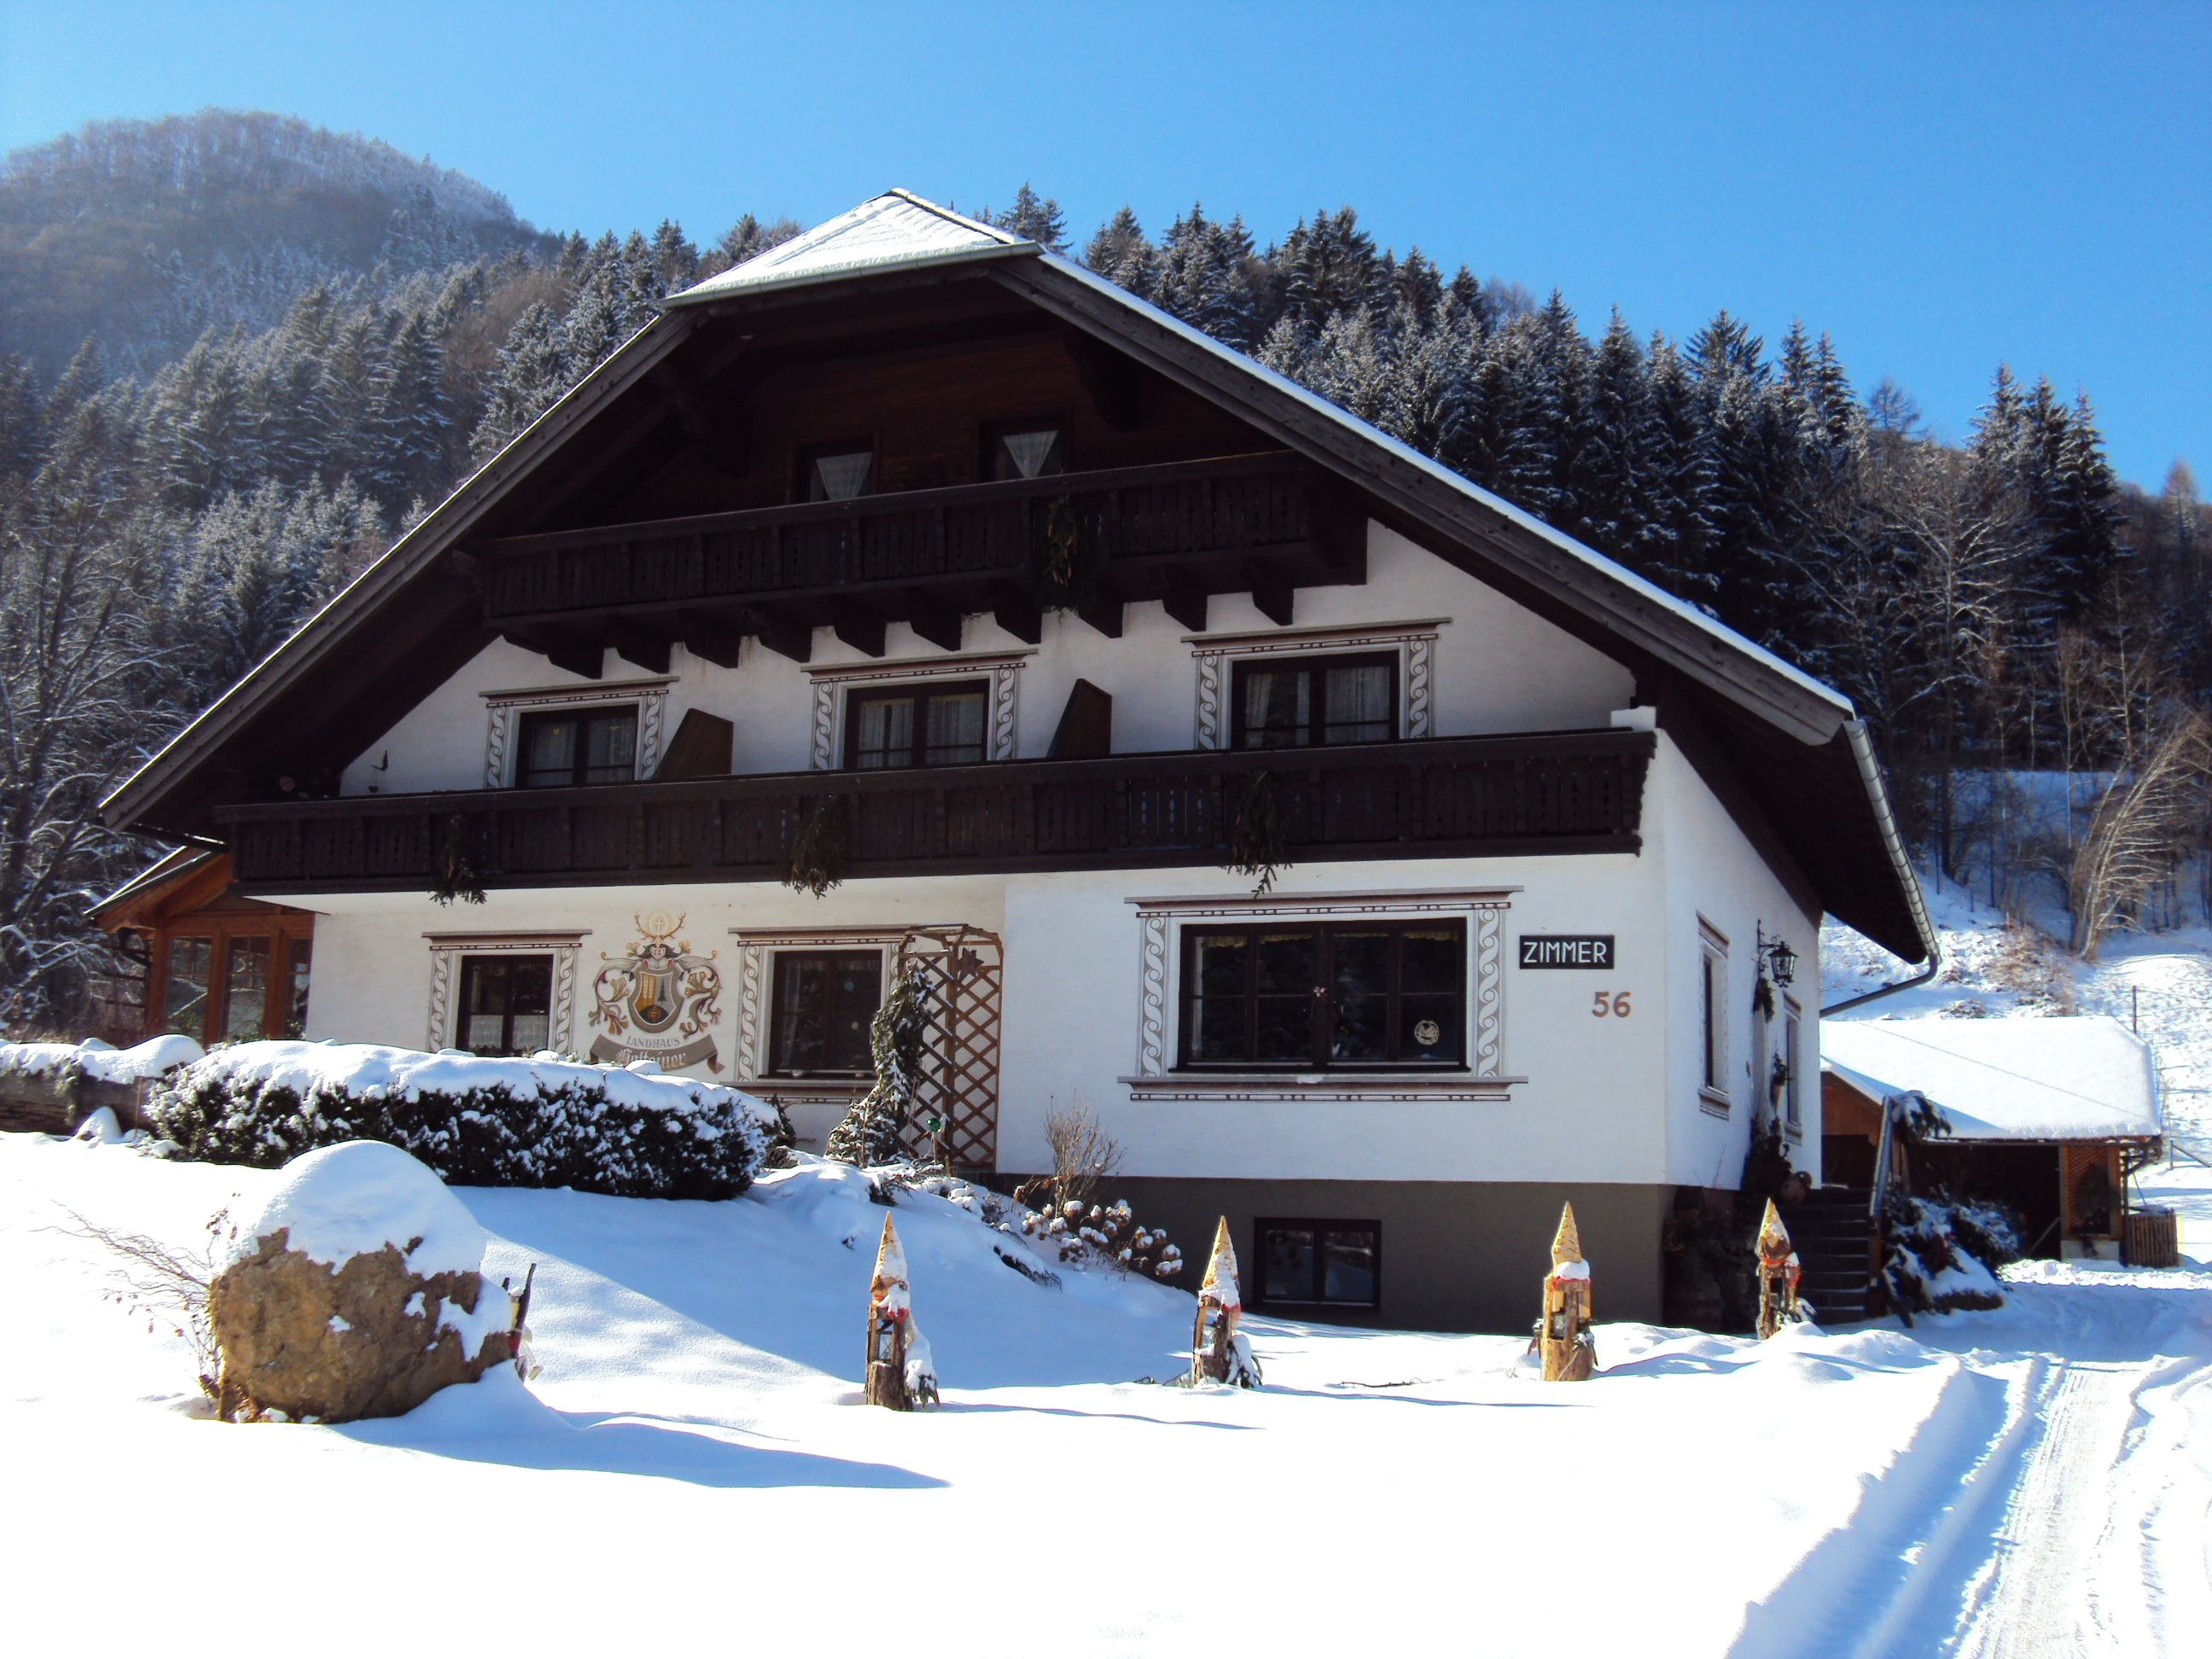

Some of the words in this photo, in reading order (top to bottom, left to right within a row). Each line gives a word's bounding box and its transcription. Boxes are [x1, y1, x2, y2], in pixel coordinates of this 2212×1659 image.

[1523, 941, 1606, 963] ZIMMER
[1592, 991, 1632, 1018] 56
[627, 1035, 680, 1049] LANDHAUS
